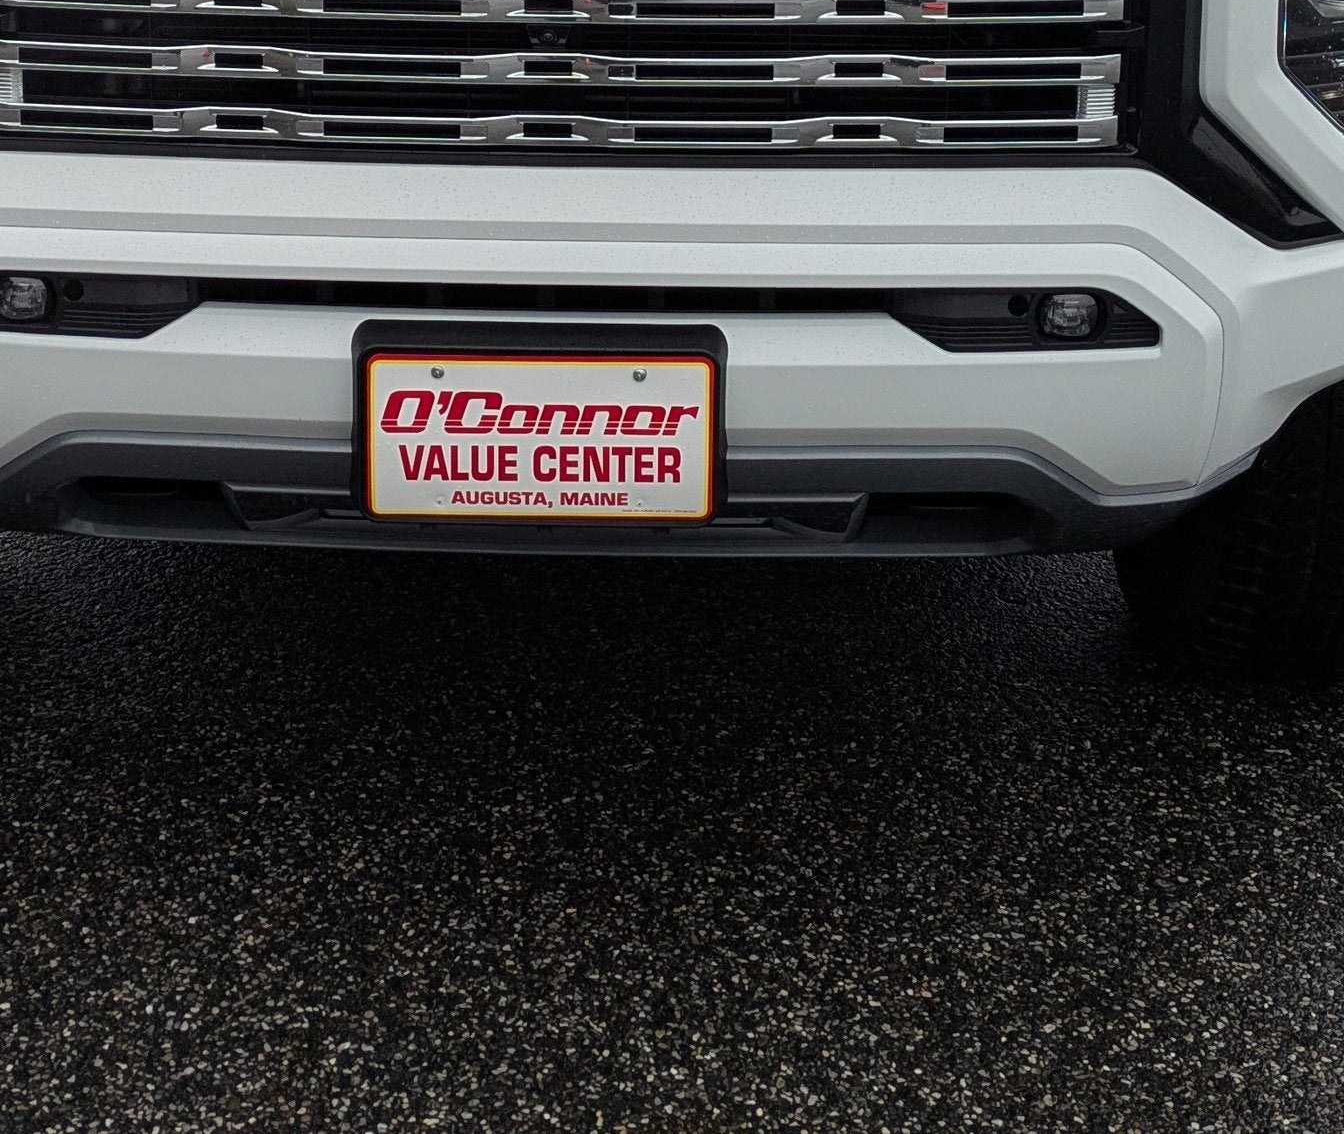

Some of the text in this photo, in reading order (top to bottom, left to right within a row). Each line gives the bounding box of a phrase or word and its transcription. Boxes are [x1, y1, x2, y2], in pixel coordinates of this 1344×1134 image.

[380, 390, 699, 436] O'Connor
[398, 444, 682, 483] VALUE CENTER
[451, 490, 629, 507] AUGUSTA, MAINE
